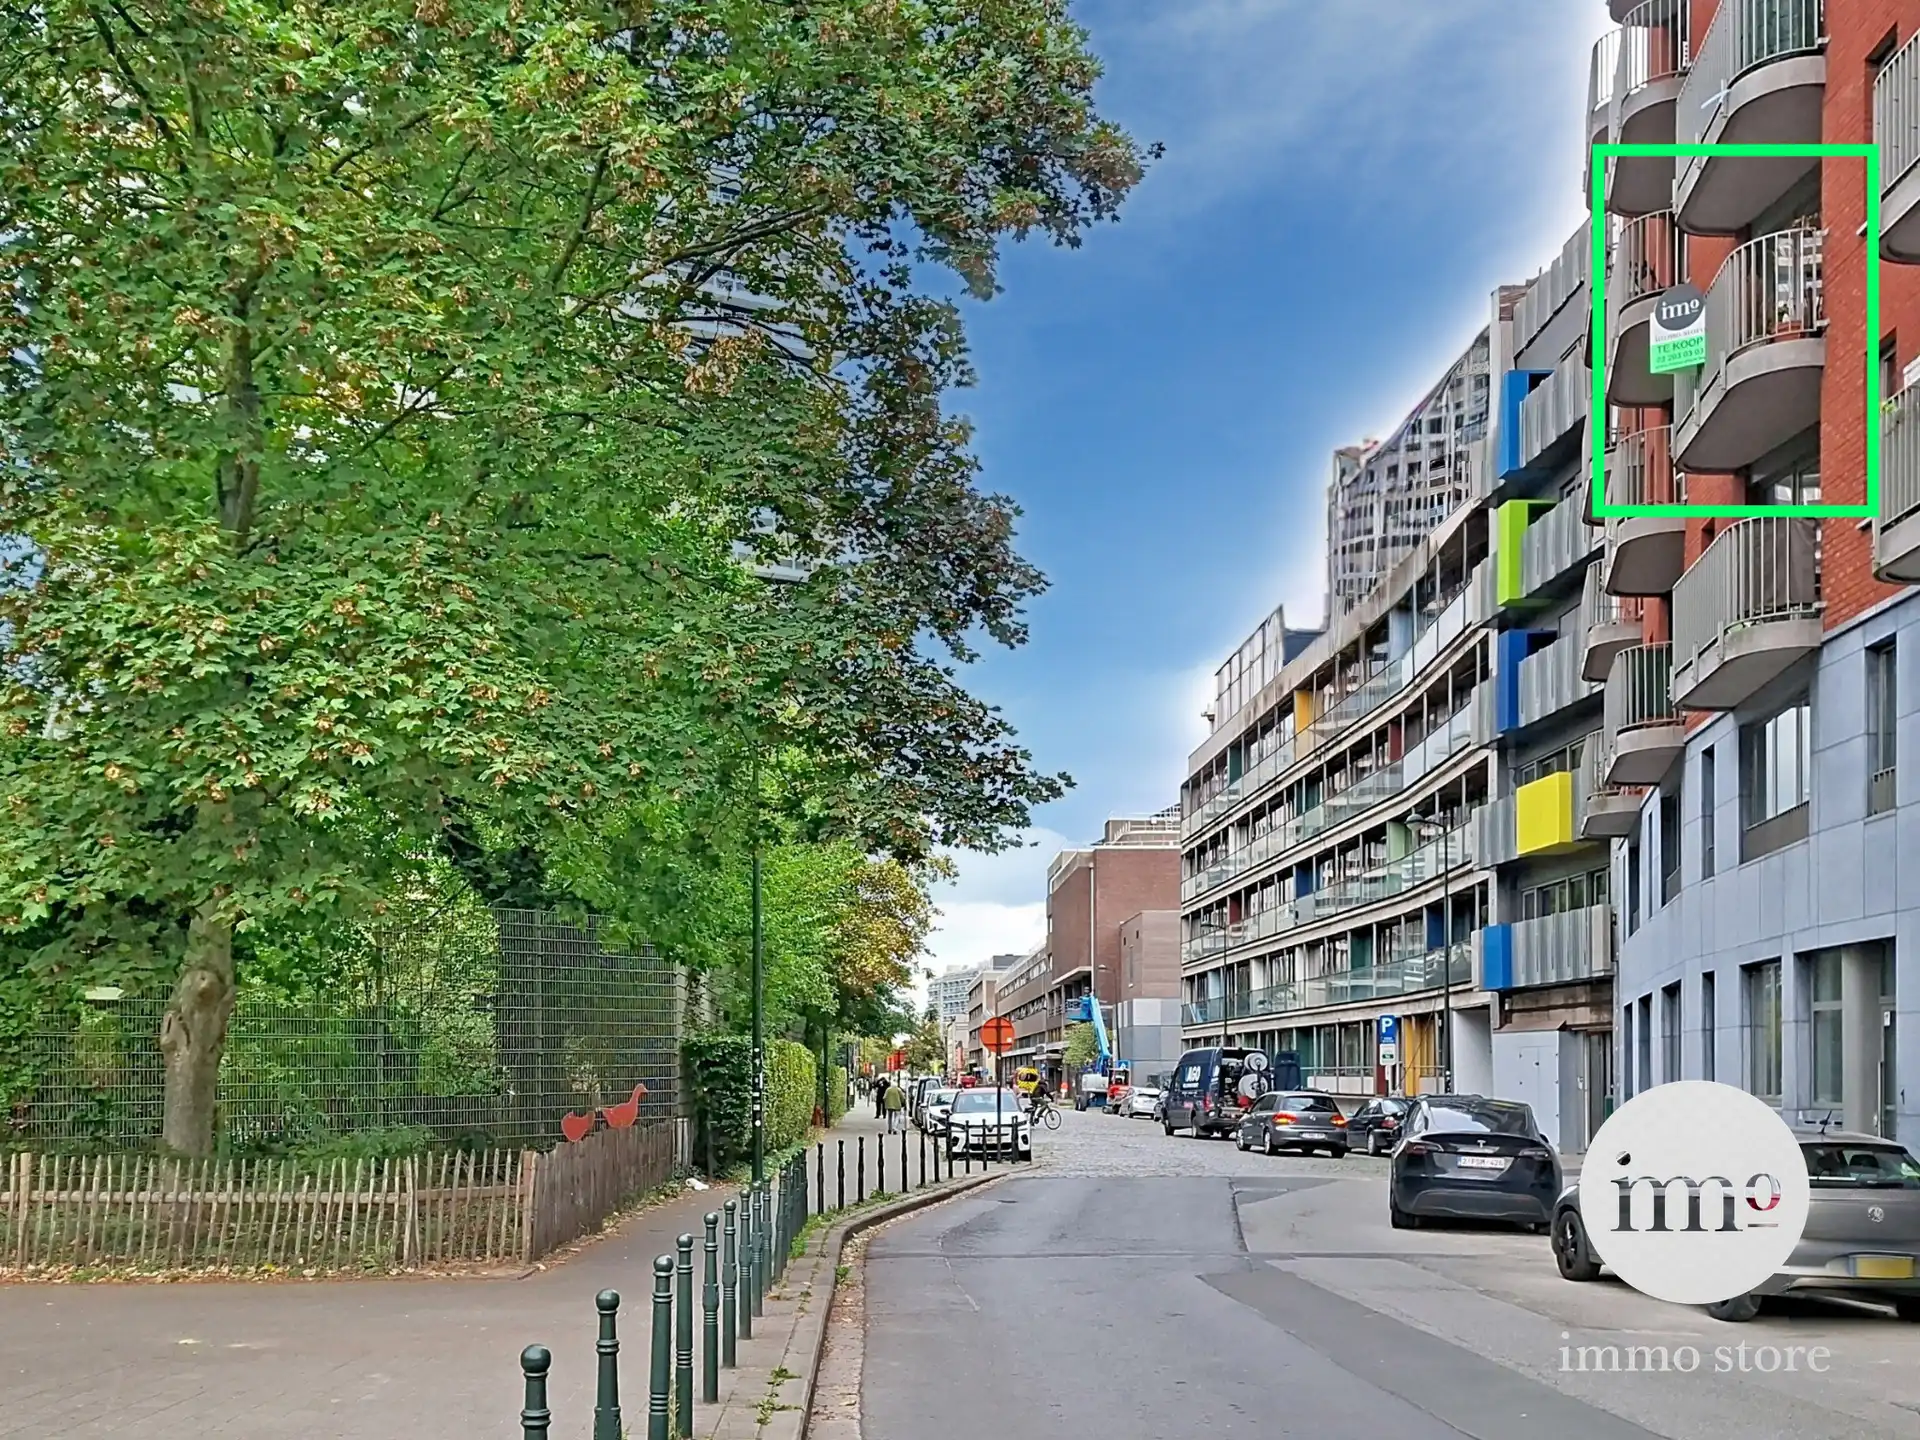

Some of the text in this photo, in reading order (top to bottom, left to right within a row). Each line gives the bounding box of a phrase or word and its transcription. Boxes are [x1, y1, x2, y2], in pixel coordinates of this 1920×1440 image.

[1657, 336, 1704, 354] TE KOOP
[1381, 1017, 1393, 1034] P
